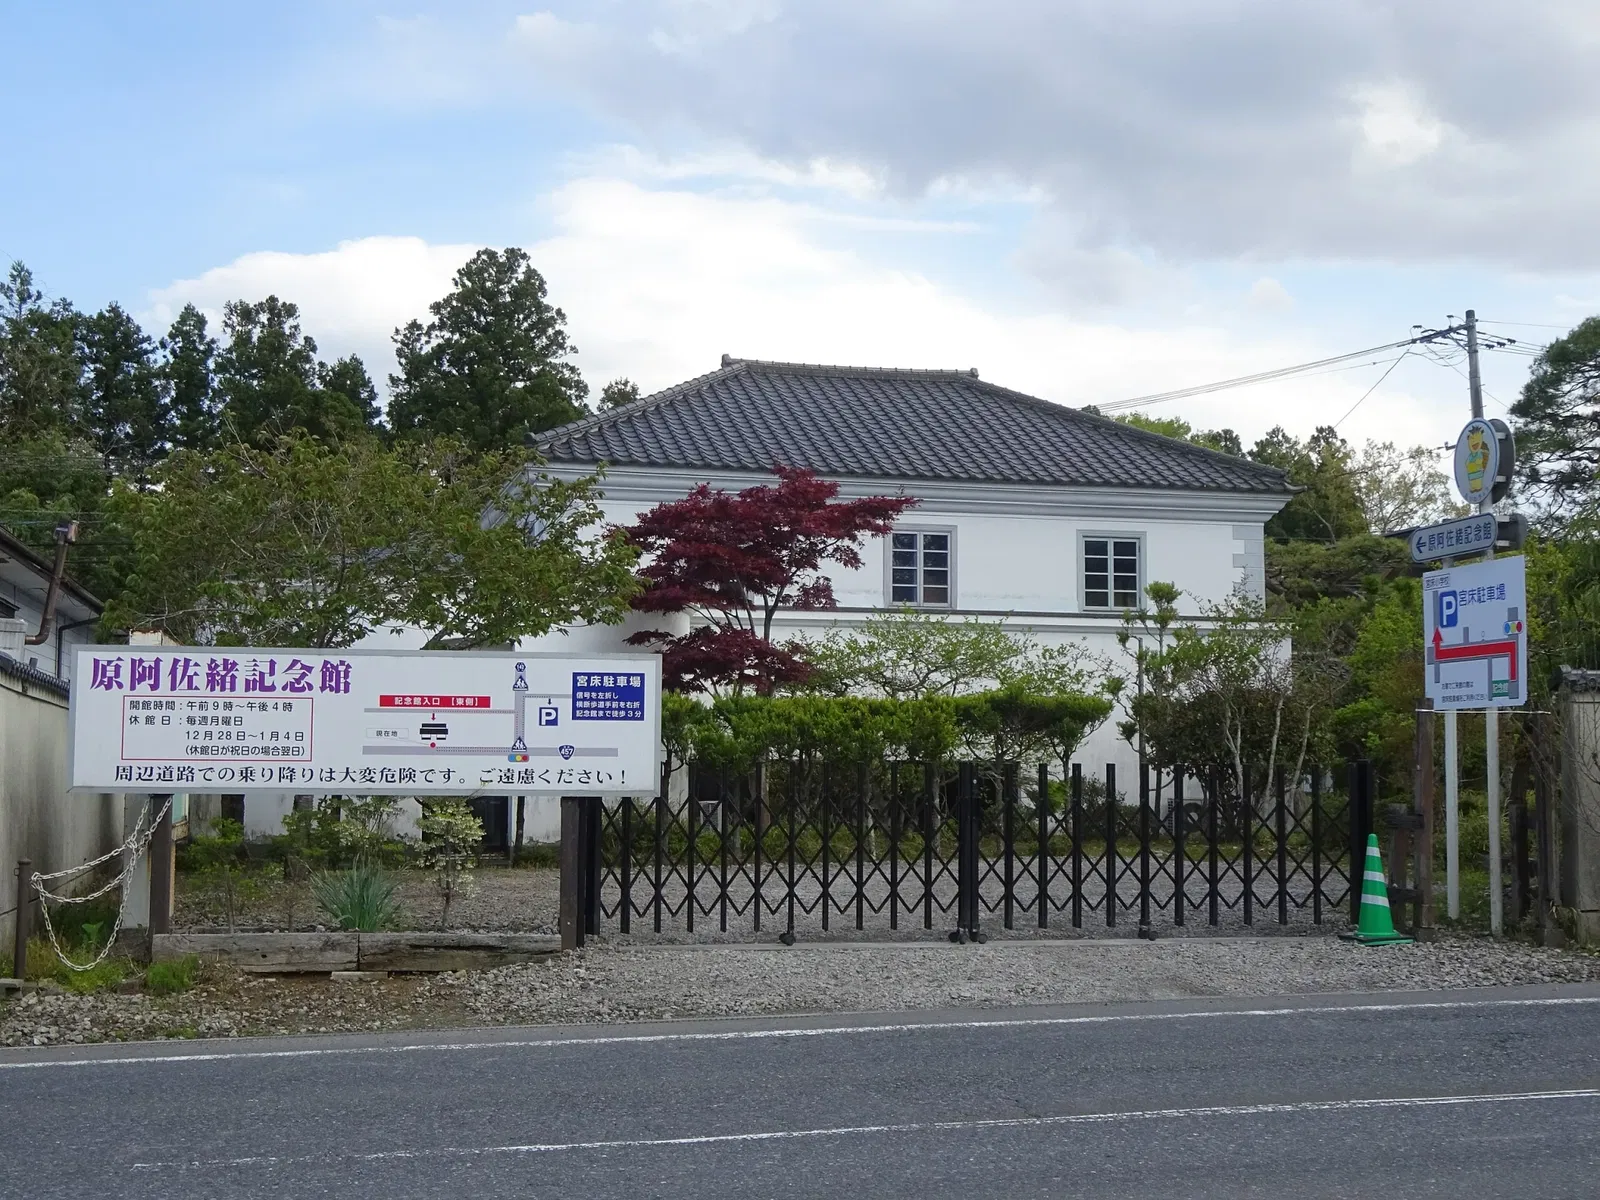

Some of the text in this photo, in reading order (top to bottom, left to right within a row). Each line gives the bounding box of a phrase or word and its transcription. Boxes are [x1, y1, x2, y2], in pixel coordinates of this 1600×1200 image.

[1428, 521, 1492, 551] 原阿佐緒記念館
[1458, 583, 1506, 606] 宮床駐車場
[1442, 595, 1456, 626] P
[89, 656, 353, 694] 原阿佐緒記念館
[576, 675, 641, 687] 宮床駐車場
[394, 696, 440, 706] 記念館入口
[576, 691, 619, 699] 信号を左折し
[576, 701, 640, 709] 横断歩道手前を右折
[541, 708, 556, 725] P
[576, 710, 642, 718] 記念館まで徒歩3分
[376, 729, 398, 737] 現在地
[184, 745, 306, 757] （休館日が祝日の場合翌日）
